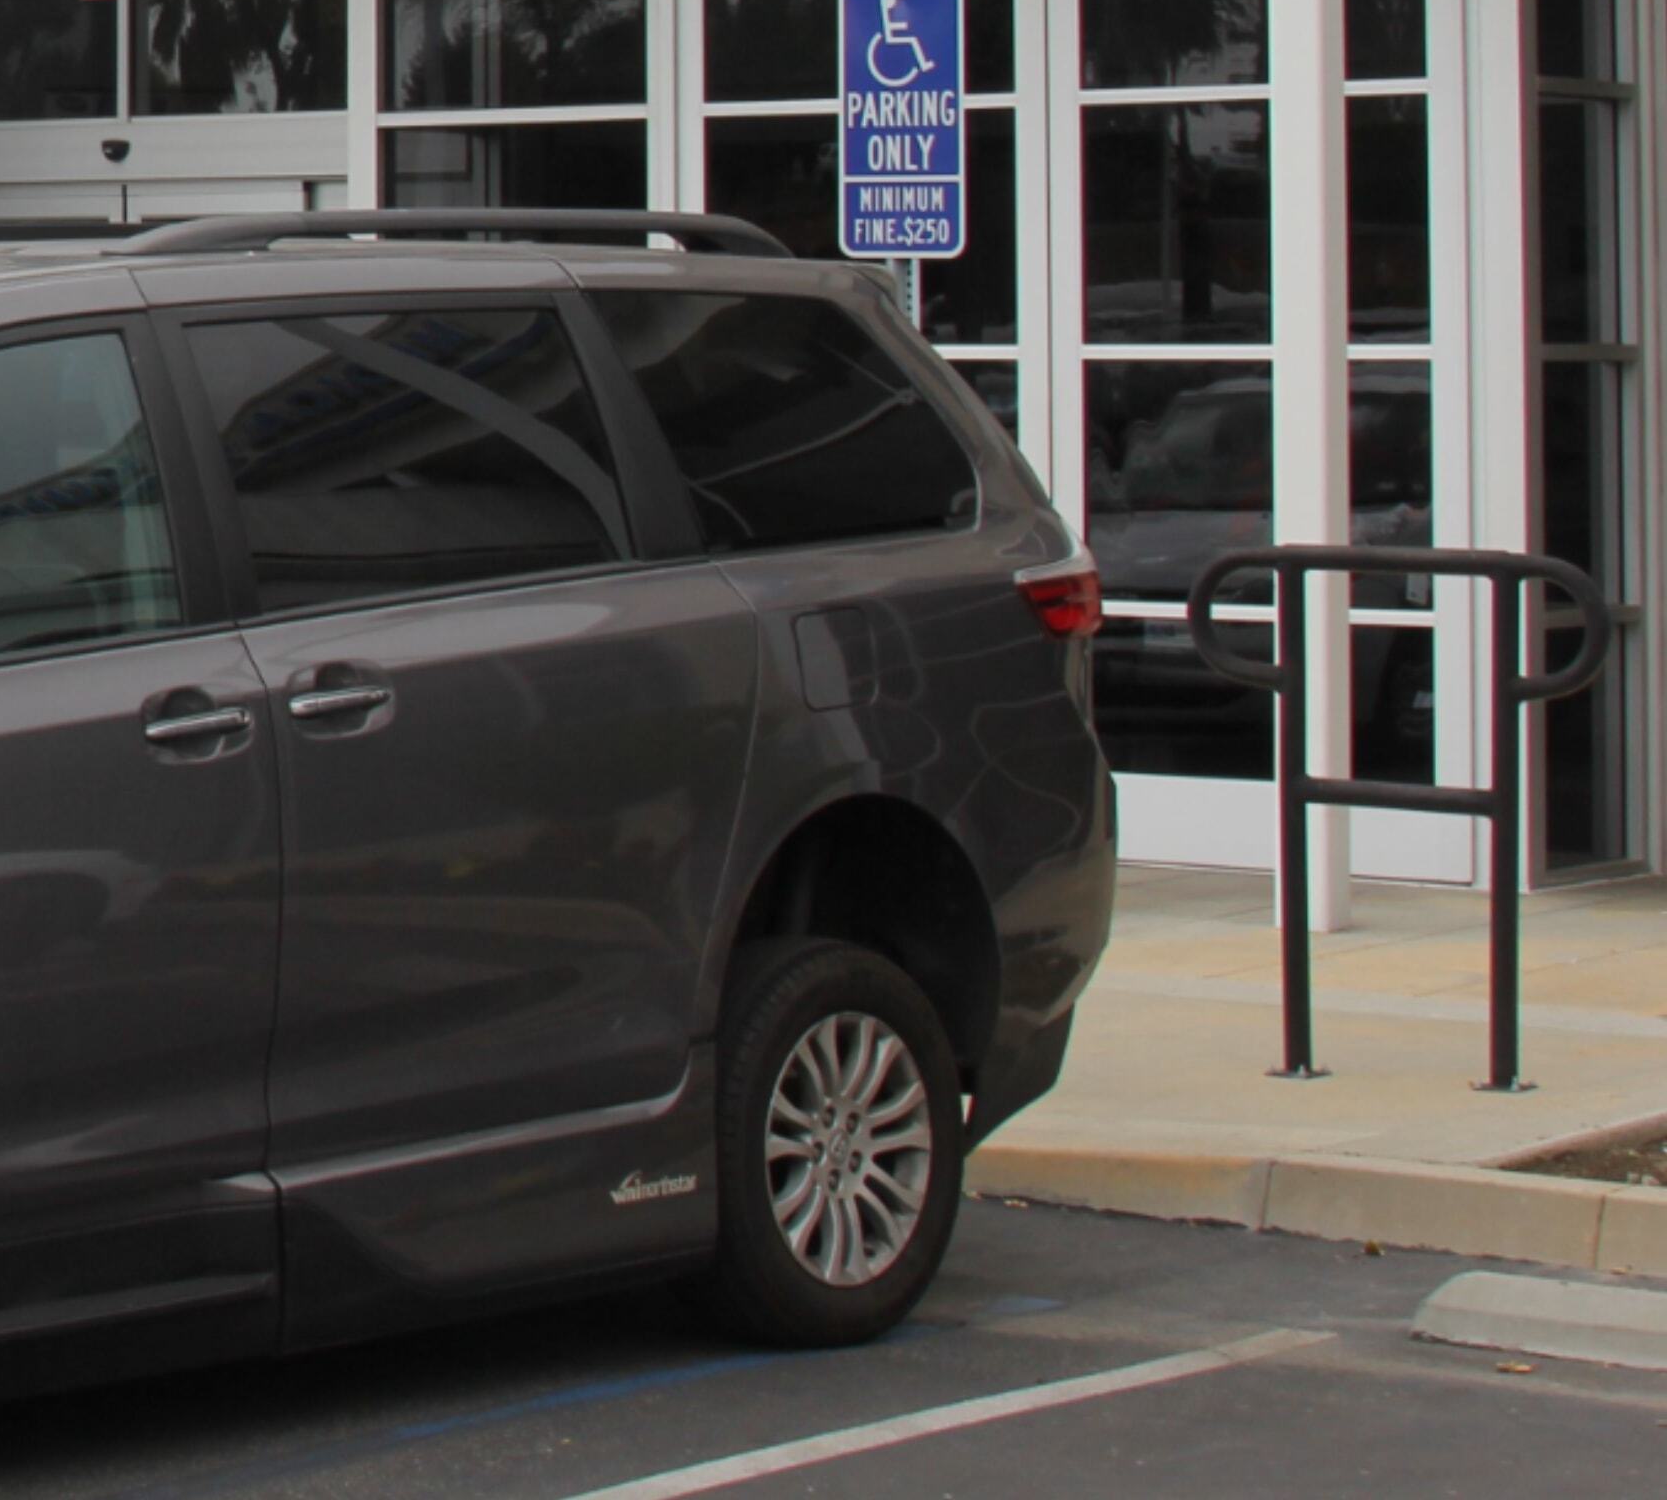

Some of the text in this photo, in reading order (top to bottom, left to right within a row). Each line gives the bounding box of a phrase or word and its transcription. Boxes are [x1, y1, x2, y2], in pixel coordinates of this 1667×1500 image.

[847, 91, 956, 128] PARKING
[867, 134, 935, 172] ONLY
[860, 185, 943, 212] MINIMUM
